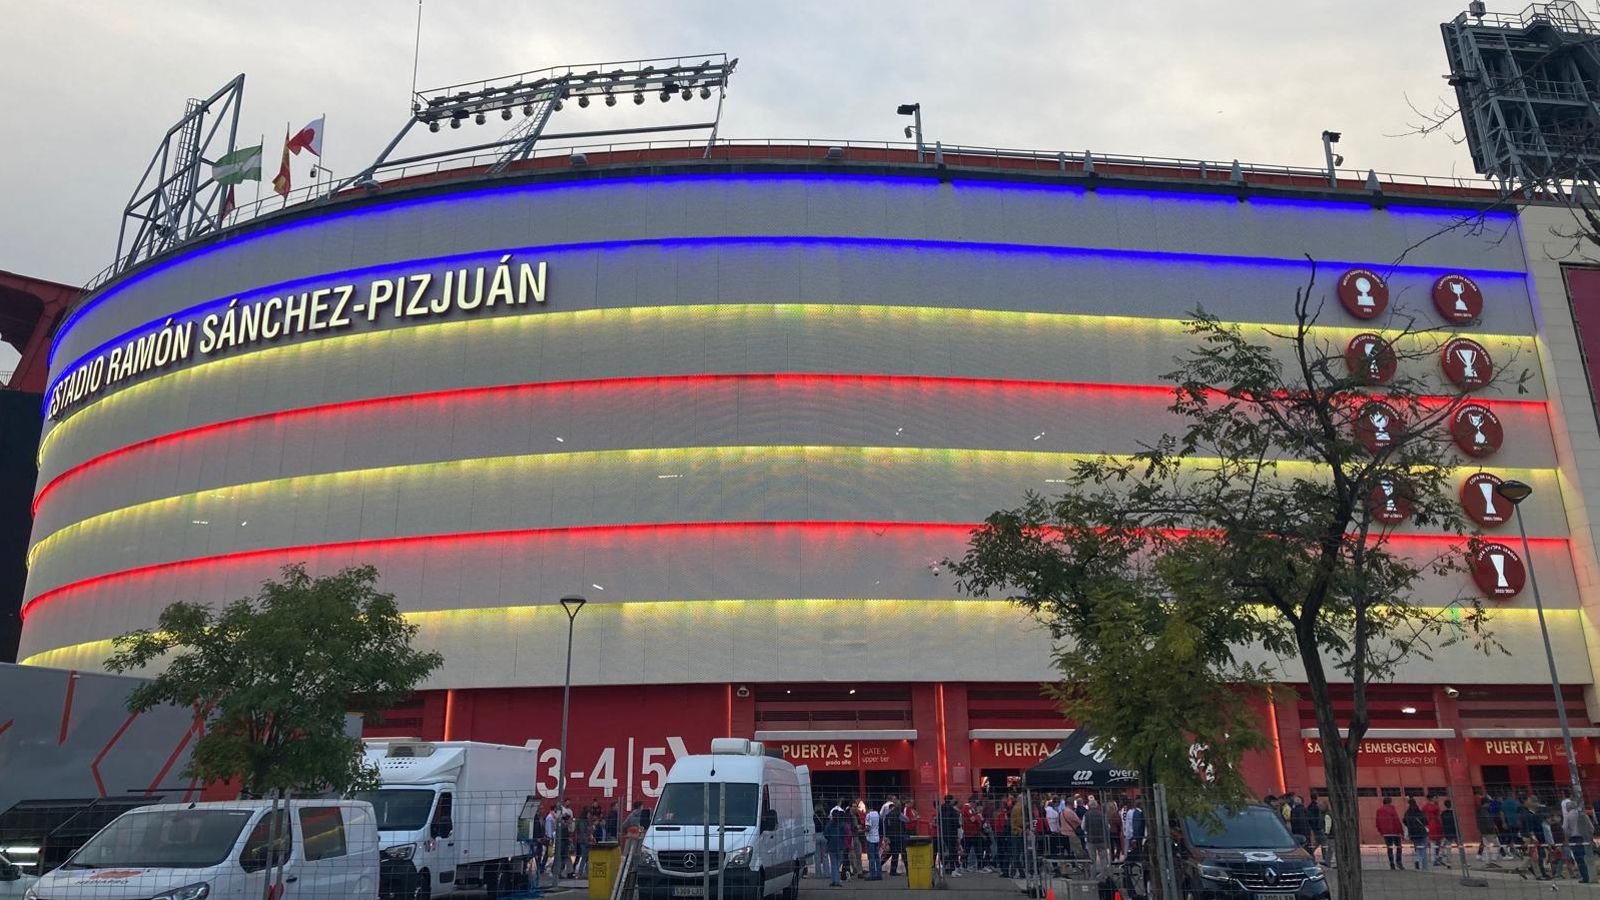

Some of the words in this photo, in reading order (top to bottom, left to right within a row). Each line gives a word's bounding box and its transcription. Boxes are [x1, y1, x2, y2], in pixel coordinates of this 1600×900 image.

[48, 355, 104, 419] ESTADIO
[106, 318, 193, 385] RAMÓN
[199, 254, 547, 354] SÁNCHEZ-PIZJUÁN
[782, 744, 838, 758] PUERTA
[843, 744, 853, 758] 5
[862, 747, 881, 756] GATE
[994, 742, 1051, 757] PUERTA
[1365, 743, 1436, 754] EMERGENCIA
[1486, 741, 1535, 754] PUERTA
[1537, 741, 1545, 753] 7
[1384, 757, 1422, 765] EMERGENCY
[1424, 757, 1438, 765] EXIT
